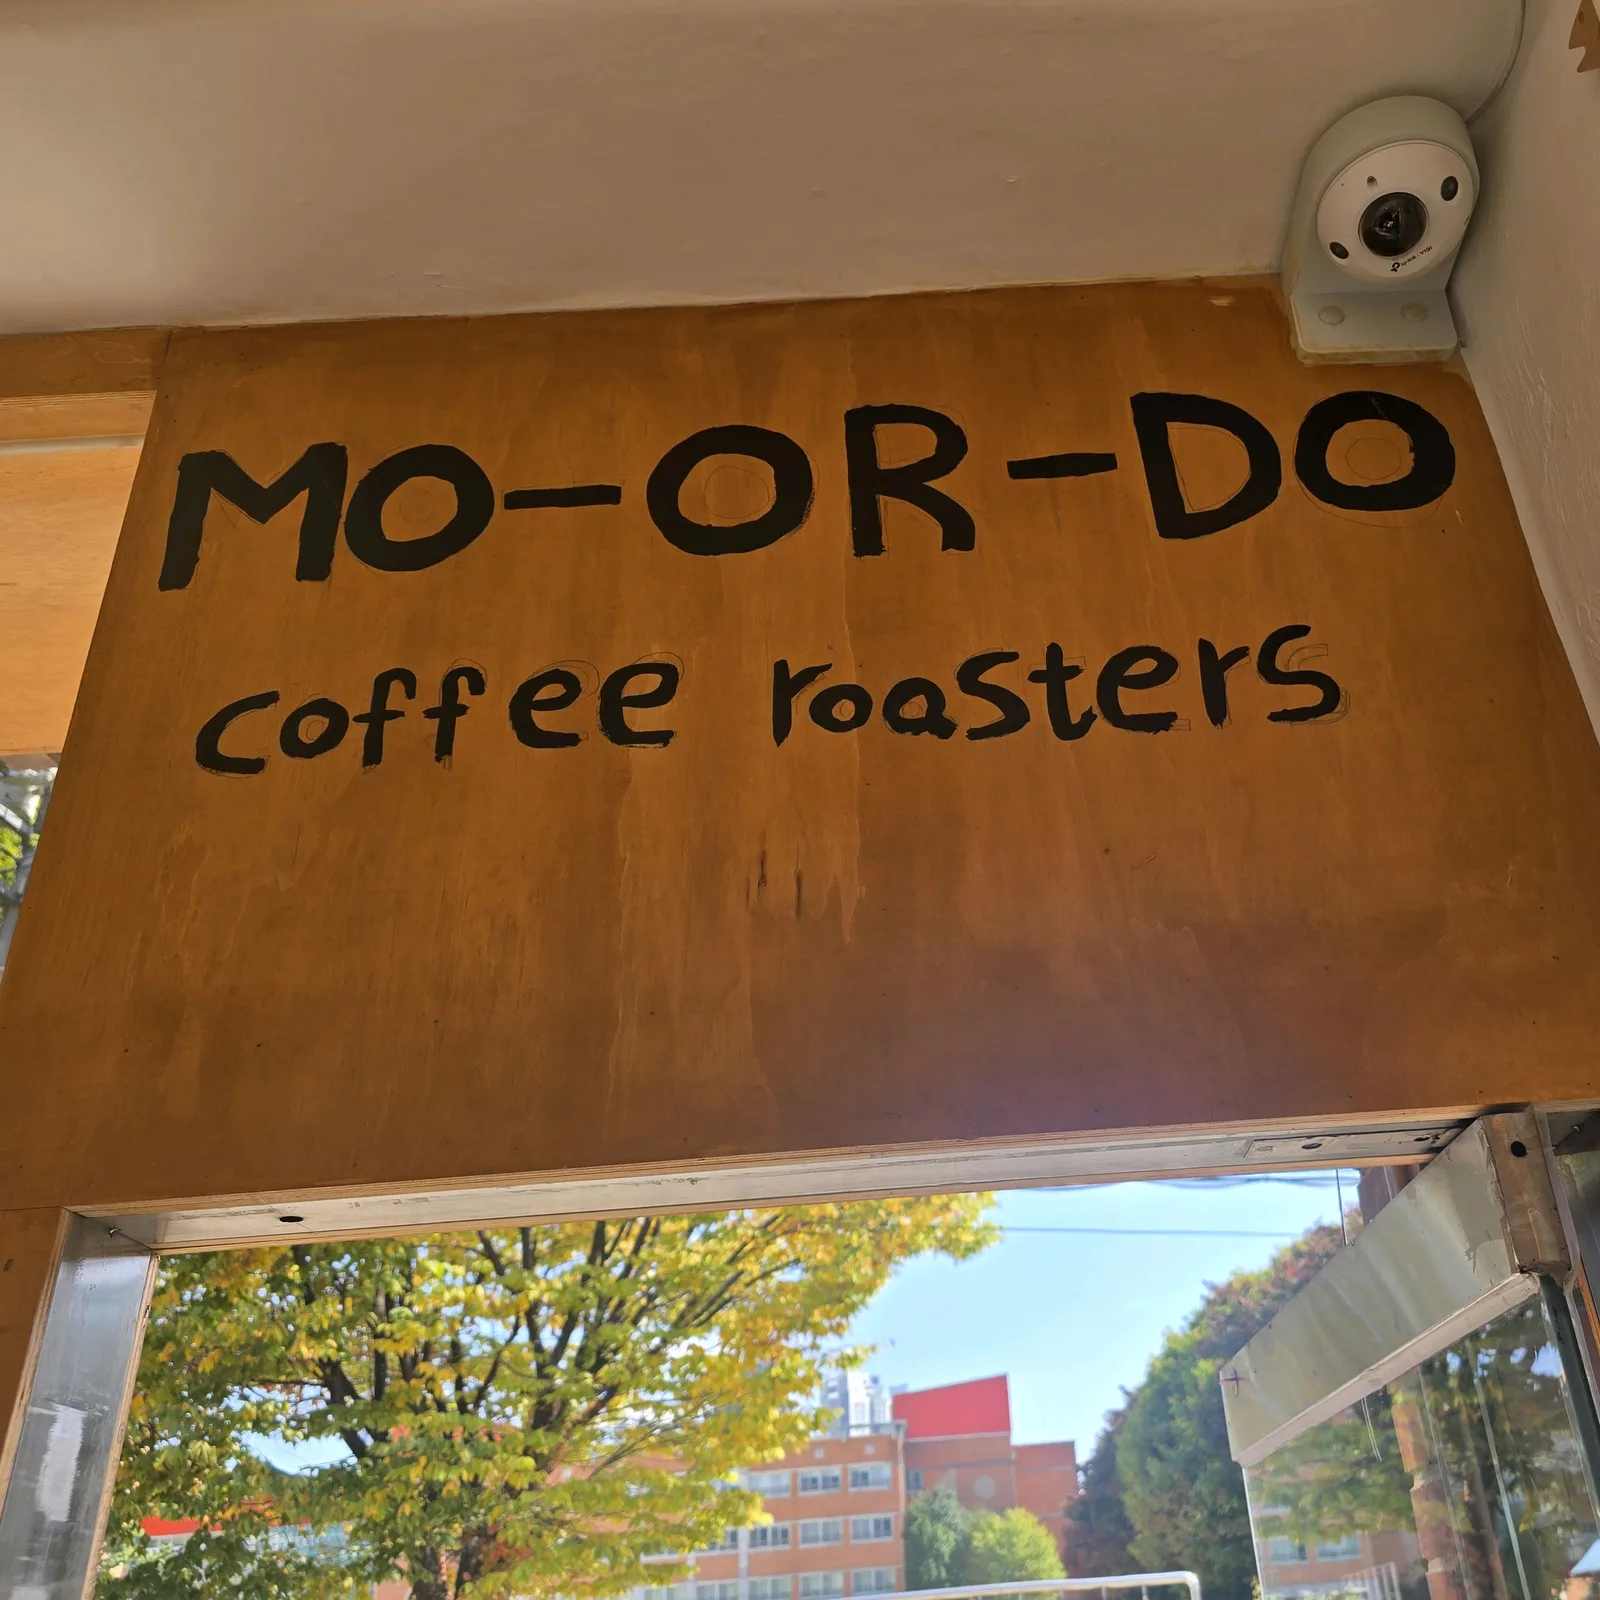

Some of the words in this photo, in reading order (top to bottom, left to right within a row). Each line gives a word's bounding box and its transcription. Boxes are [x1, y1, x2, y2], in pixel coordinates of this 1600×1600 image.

[1419, 245, 1433, 255] VIGI
[158, 391, 1456, 591] MO-OR-DO
[196, 662, 680, 774] coffee
[773, 625, 1342, 747] roasters
